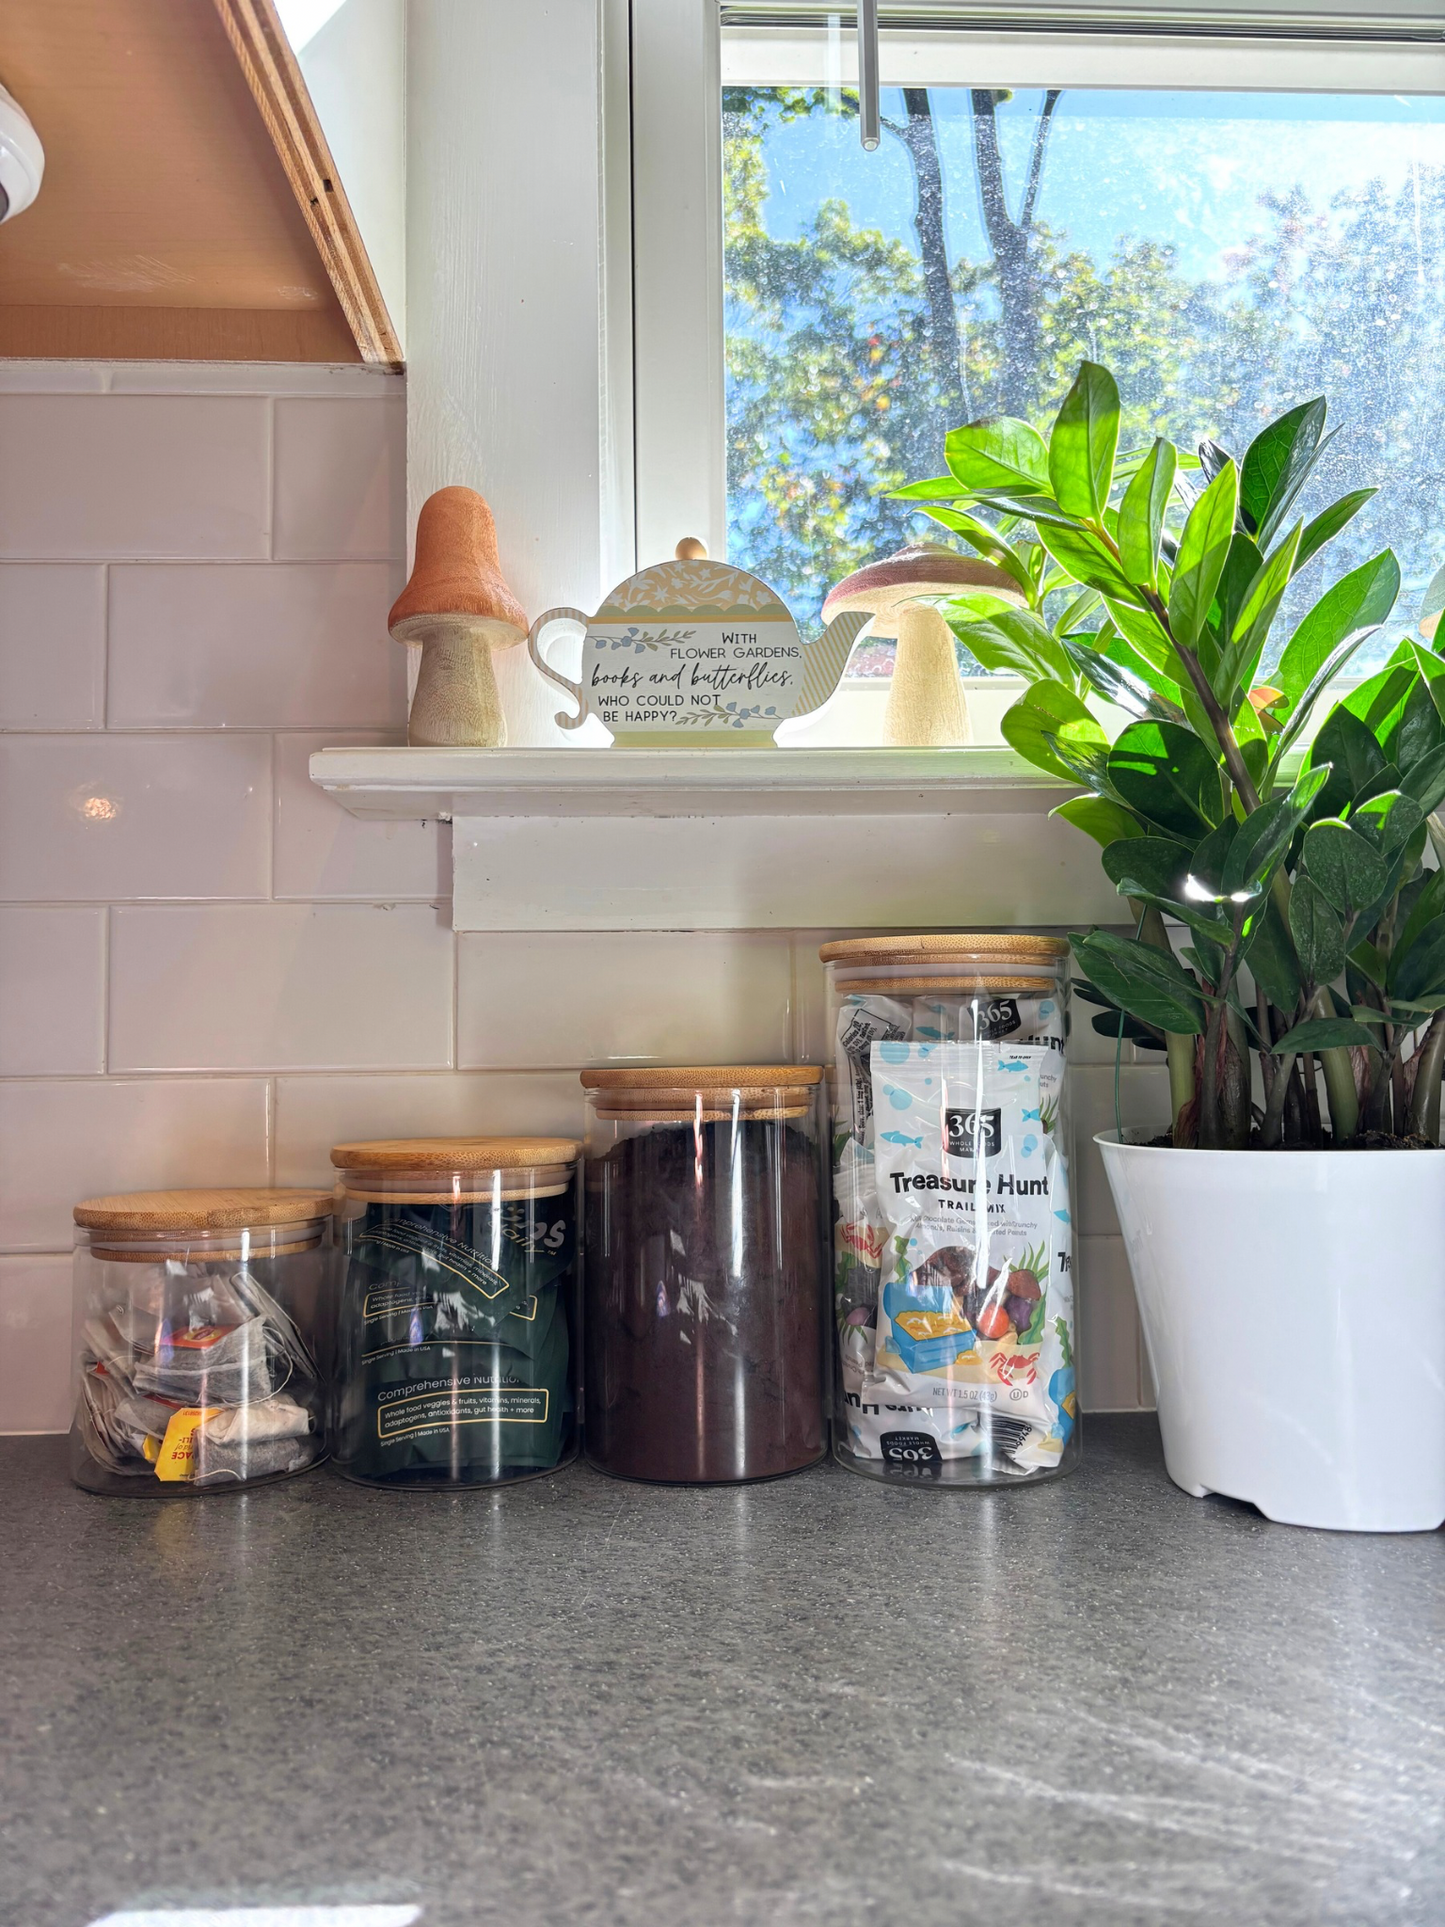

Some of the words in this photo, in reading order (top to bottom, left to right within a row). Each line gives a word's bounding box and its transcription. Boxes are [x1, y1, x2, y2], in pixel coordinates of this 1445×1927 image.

[721, 632, 757, 645] WITH
[670, 648, 726, 659] FLOWER
[592, 663, 643, 688] books
[649, 663, 686, 690] and
[598, 695, 630, 706] WHO
[636, 695, 684, 706] COULD
[691, 694, 721, 705] NOT
[603, 711, 619, 722] BE
[625, 711, 677, 722] HAPPY?
[977, 1000, 1012, 1031] 365
[1040, 1074, 1057, 1082] unchy
[949, 1112, 995, 1138] 365
[997, 1173, 1049, 1195] Hunt
[938, 1199, 976, 1211] TRAIL
[987, 1204, 1006, 1213] MIX
[458, 1241, 495, 1266] Nutritio
[377, 1375, 470, 1401] Comprehensive
[933, 1387, 945, 1396] NET
[958, 1389, 968, 1399] 1.5
[969, 1391, 978, 1400] OZ
[385, 1409, 405, 1419] Whole
[406, 1404, 421, 1413] food
[423, 1399, 450, 1409] veggies
[479, 1397, 509, 1405] vitamins,
[511, 1397, 541, 1405] minerals,
[384, 1413, 427, 1428] adaptogens,
[428, 1406, 473, 1418] antioxidants,
[474, 1406, 486, 1415] gut
[381, 1437, 395, 1447] Single
[396, 1433, 414, 1442] Serving
[889, 1446, 933, 1460] 365
